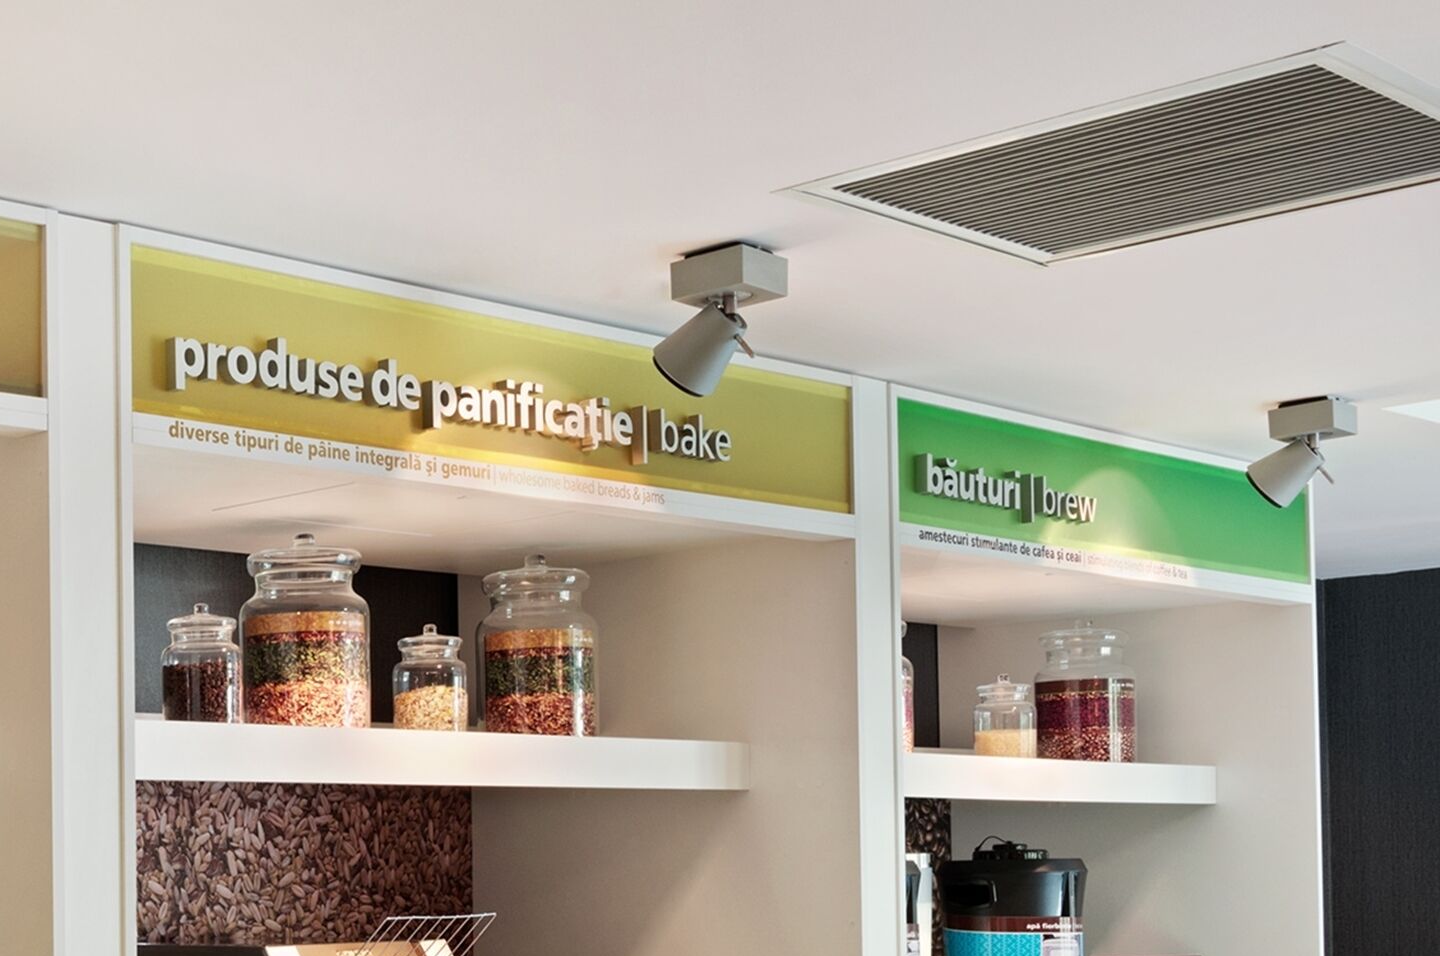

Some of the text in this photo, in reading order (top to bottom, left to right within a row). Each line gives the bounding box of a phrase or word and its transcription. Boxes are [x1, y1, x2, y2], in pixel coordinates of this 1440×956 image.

[168, 336, 365, 402] produse
[371, 358, 422, 411] de
[659, 408, 733, 462] bake
[168, 421, 230, 445] diverse
[235, 430, 279, 453] tipuri
[284, 437, 304, 454] de
[308, 441, 351, 460] pâine
[355, 446, 421, 472] integrală
[442, 461, 491, 481] gemuri
[499, 468, 561, 490] wholesome
[563, 477, 596, 495] baked
[597, 481, 631, 501] breads
[632, 486, 641, 501] &
[641, 487, 666, 505] jams
[922, 453, 1097, 523] băuturi brew
[918, 528, 969, 547] amestecuri
[971, 534, 1018, 554] stimulante
[1020, 542, 1031, 556] de
[1033, 545, 1055, 560] cafea
[1066, 550, 1081, 563] ceai
